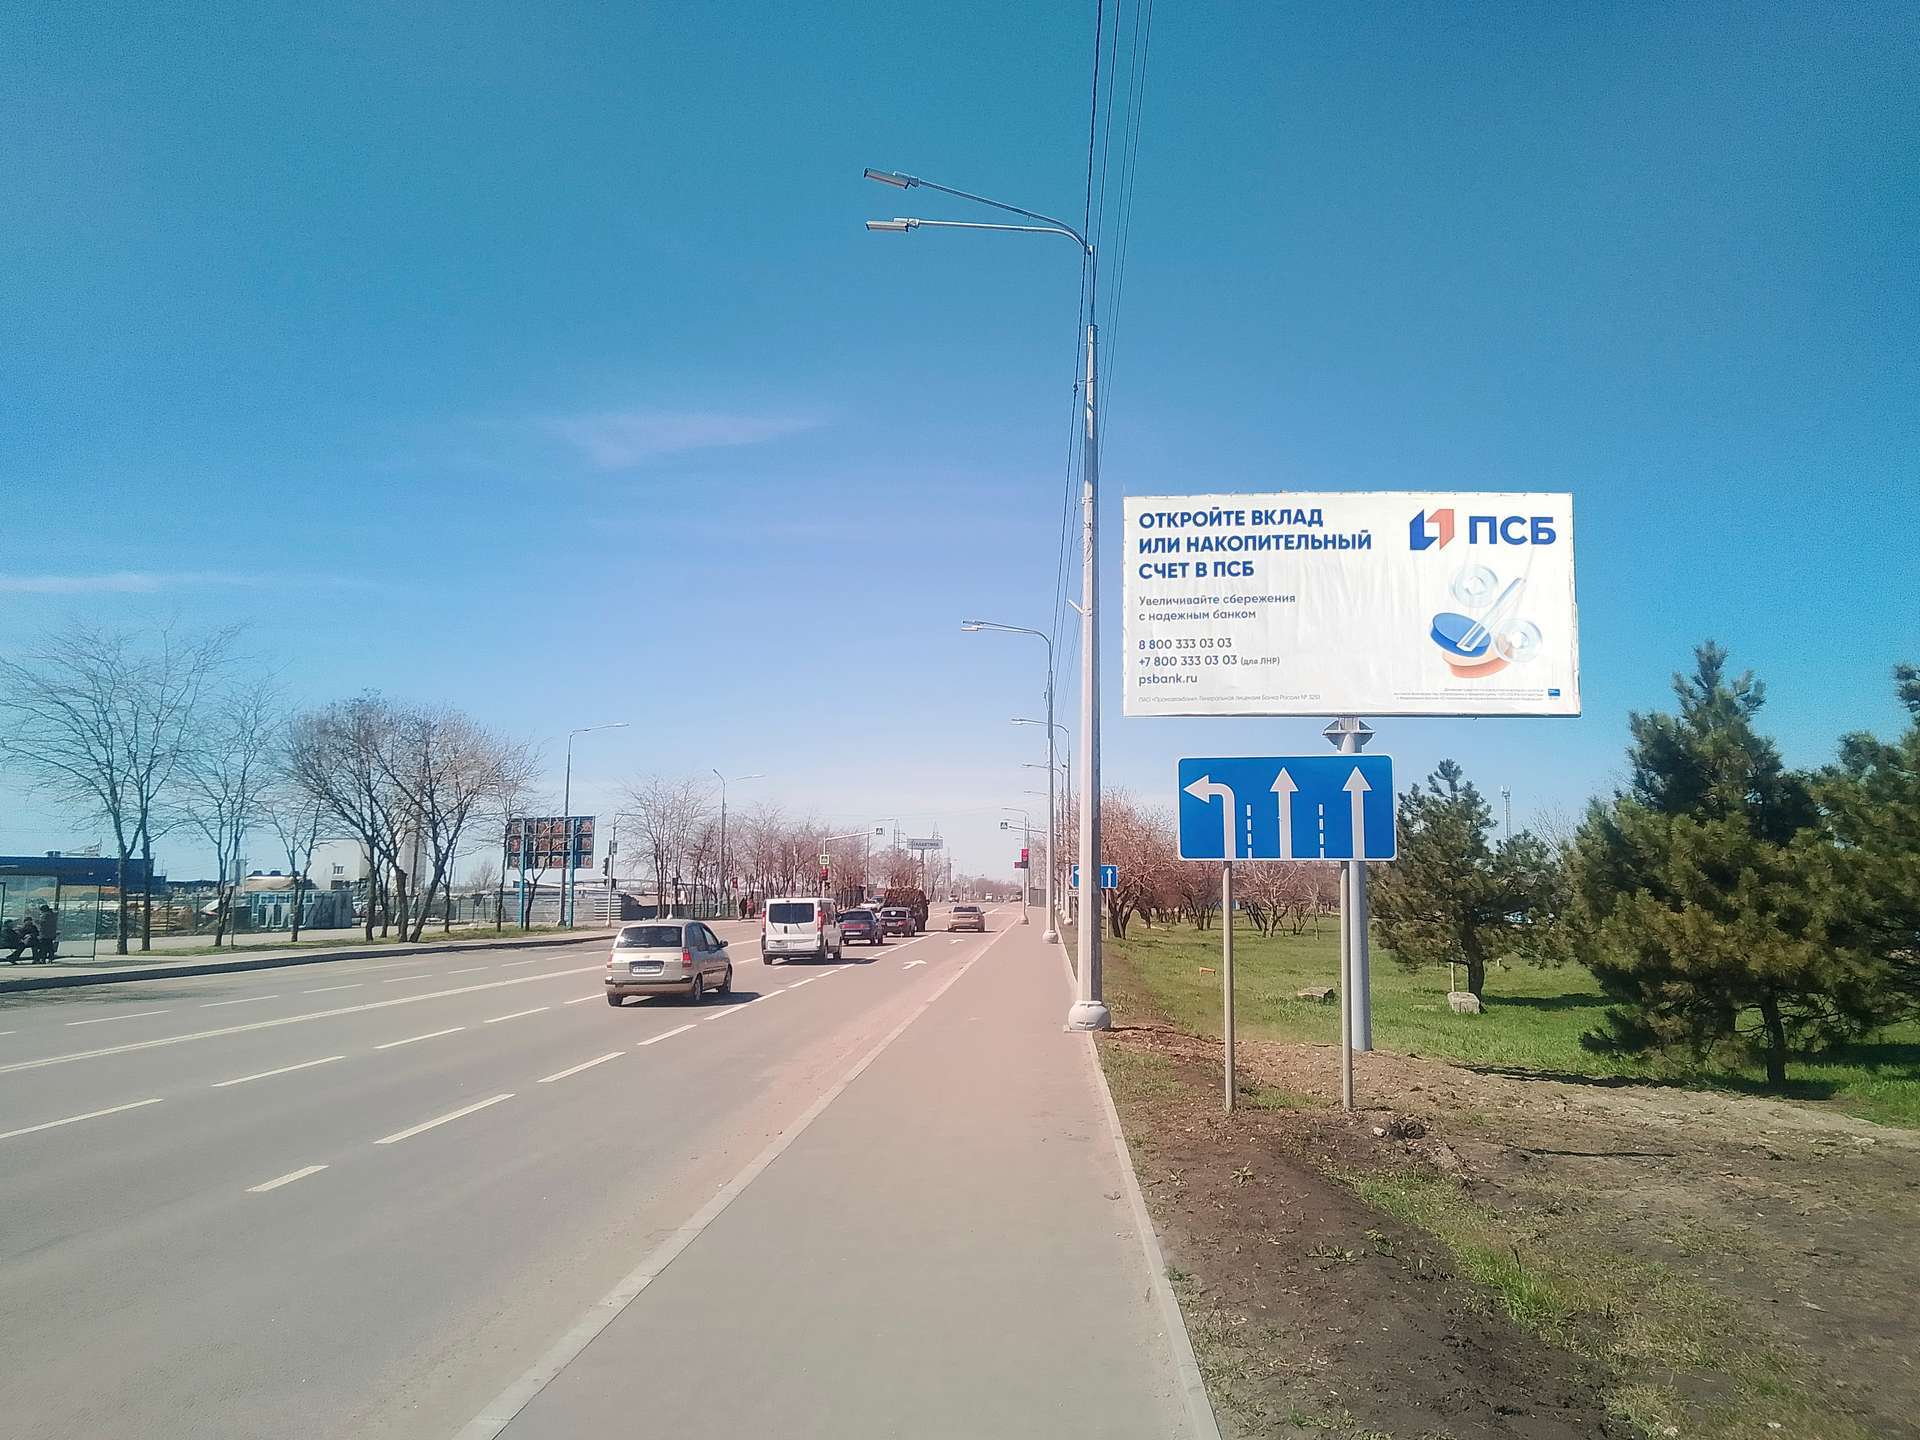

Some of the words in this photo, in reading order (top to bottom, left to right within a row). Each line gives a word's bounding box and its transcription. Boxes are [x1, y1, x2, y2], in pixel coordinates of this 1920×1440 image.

[1139, 507, 1245, 528] ОТКРОЙТЕ
[1252, 509, 1323, 527] ВКЛАД
[1469, 516, 1556, 545] ПСБ
[1140, 538, 1179, 553] ИЛИ
[1187, 530, 1371, 552] НАКОПИТЕЛЬНЫЙ
[1139, 562, 1190, 579] СЧЕТ
[1196, 562, 1207, 577] В
[1214, 561, 1254, 577] ПСБ
[1139, 596, 1219, 606] Увеличивайте
[1223, 594, 1296, 605] сбережения
[1149, 612, 1209, 622] надежным
[1213, 609, 1256, 619] банком
[1139, 640, 1145, 650] 8
[1149, 640, 1172, 650] 800
[1176, 639, 1196, 649] 333
[1200, 638, 1213, 648] 03
[1217, 638, 1232, 648] 03
[1139, 657, 1150, 667] +7
[1154, 656, 1177, 666] 800
[1181, 656, 1201, 666] 333
[1205, 655, 1218, 665] 03
[1223, 655, 1237, 665] 03
[1260, 657, 1280, 665] ЛНР)
[1138, 673, 1198, 686] psbank.ru
